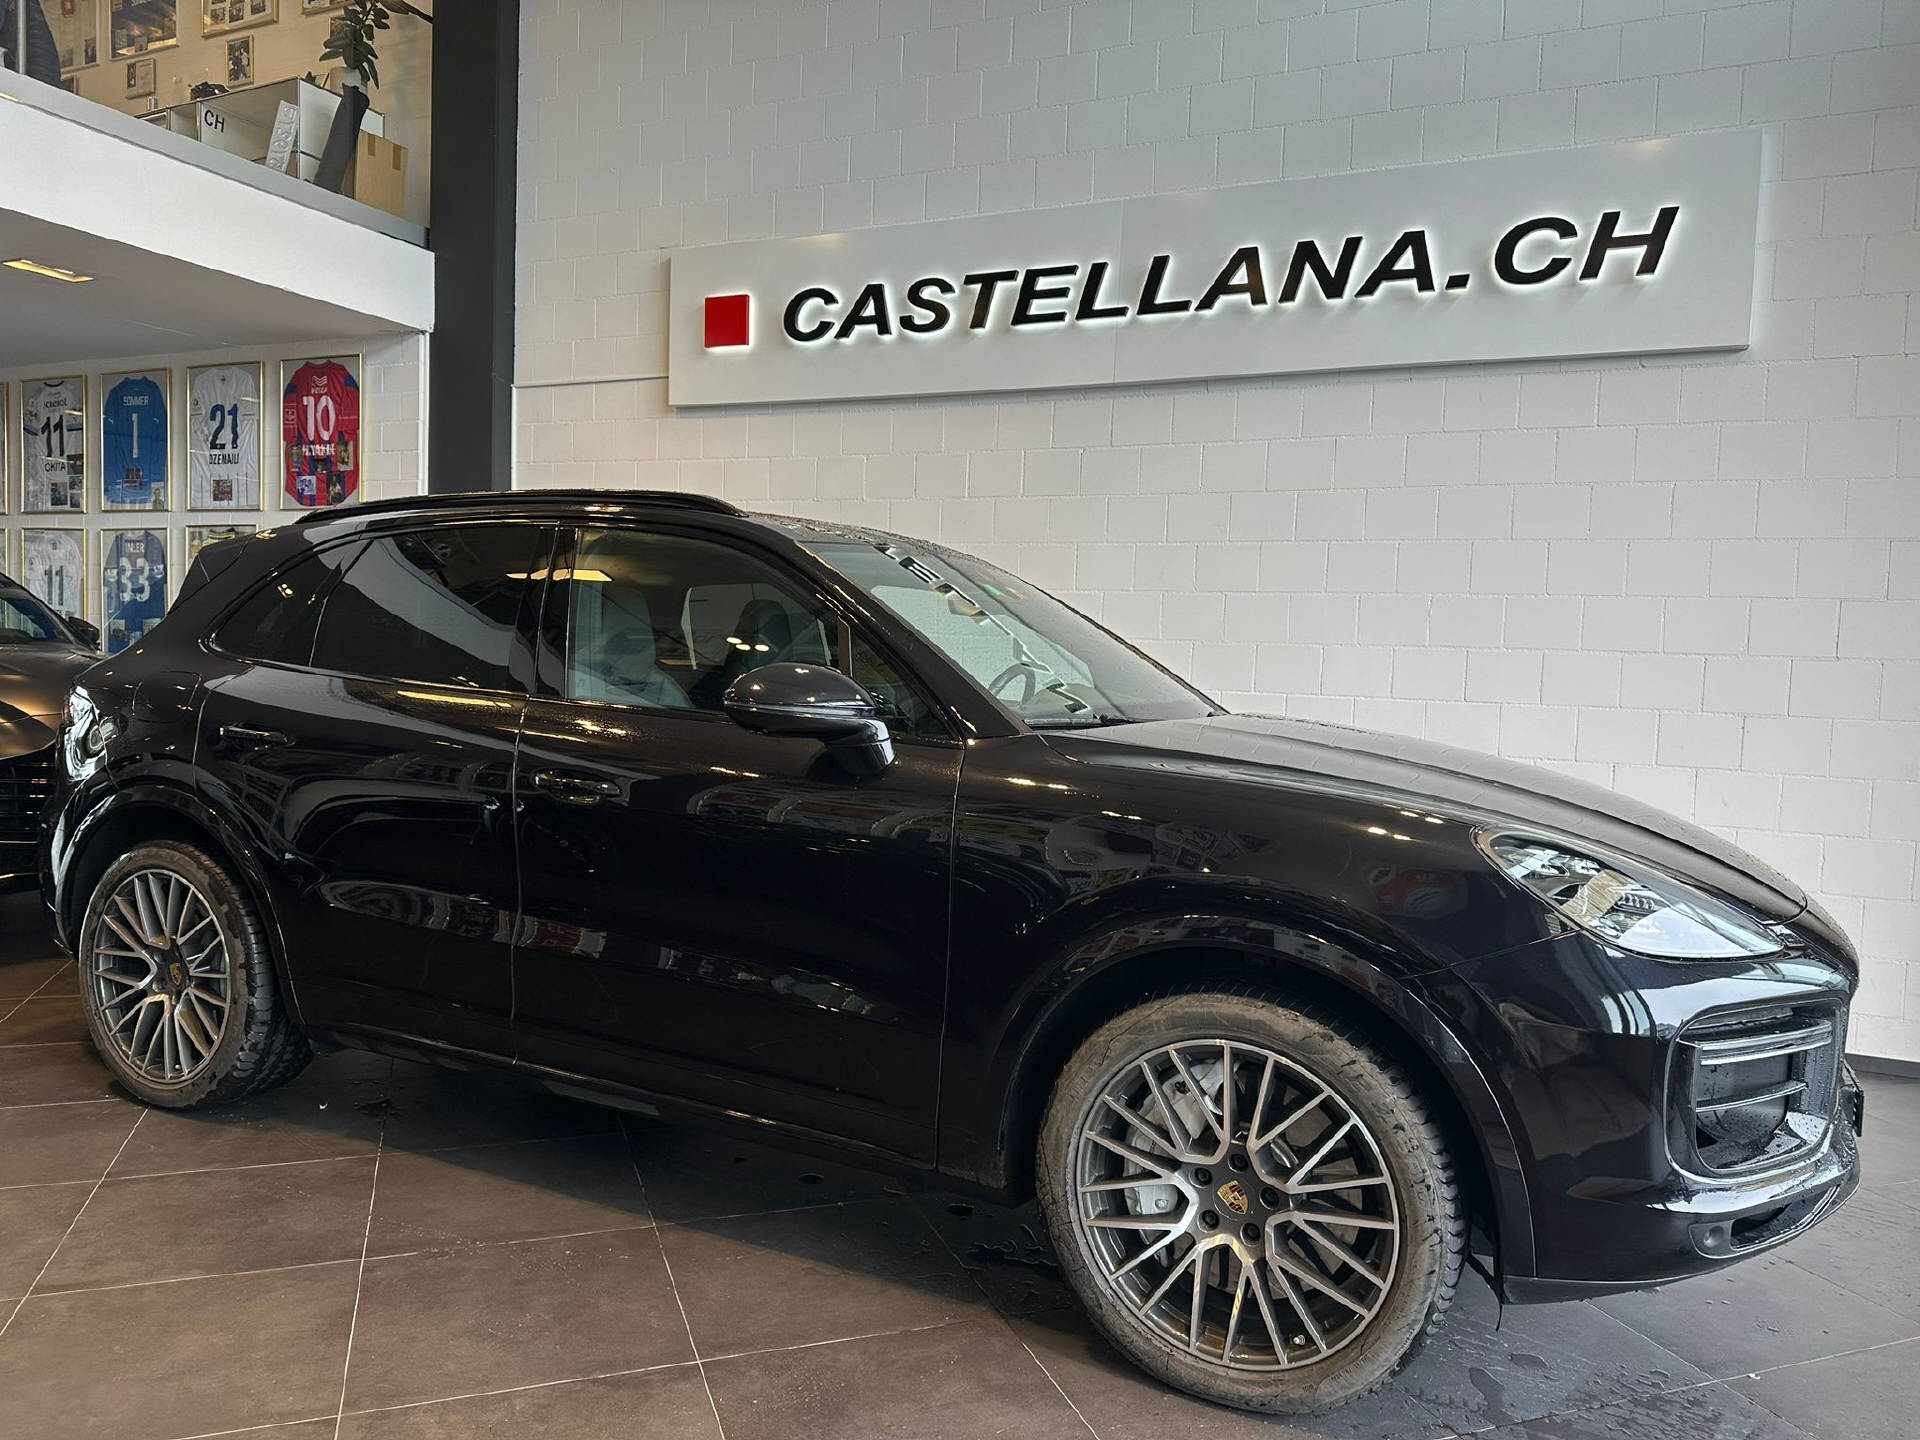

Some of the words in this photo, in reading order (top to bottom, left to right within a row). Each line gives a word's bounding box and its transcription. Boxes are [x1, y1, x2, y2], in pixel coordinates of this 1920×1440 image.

[204, 110, 225, 133] CH
[783, 206, 1680, 343] CASTELLANA.CH
[123, 396, 149, 406] SOMMER
[302, 395, 336, 441] 10
[41, 414, 65, 458] 11
[132, 412, 139, 459] 1
[210, 403, 239, 450] 21
[44, 461, 66, 473] OKITA
[44, 564, 64, 606] 11
[119, 557, 151, 602] 33
